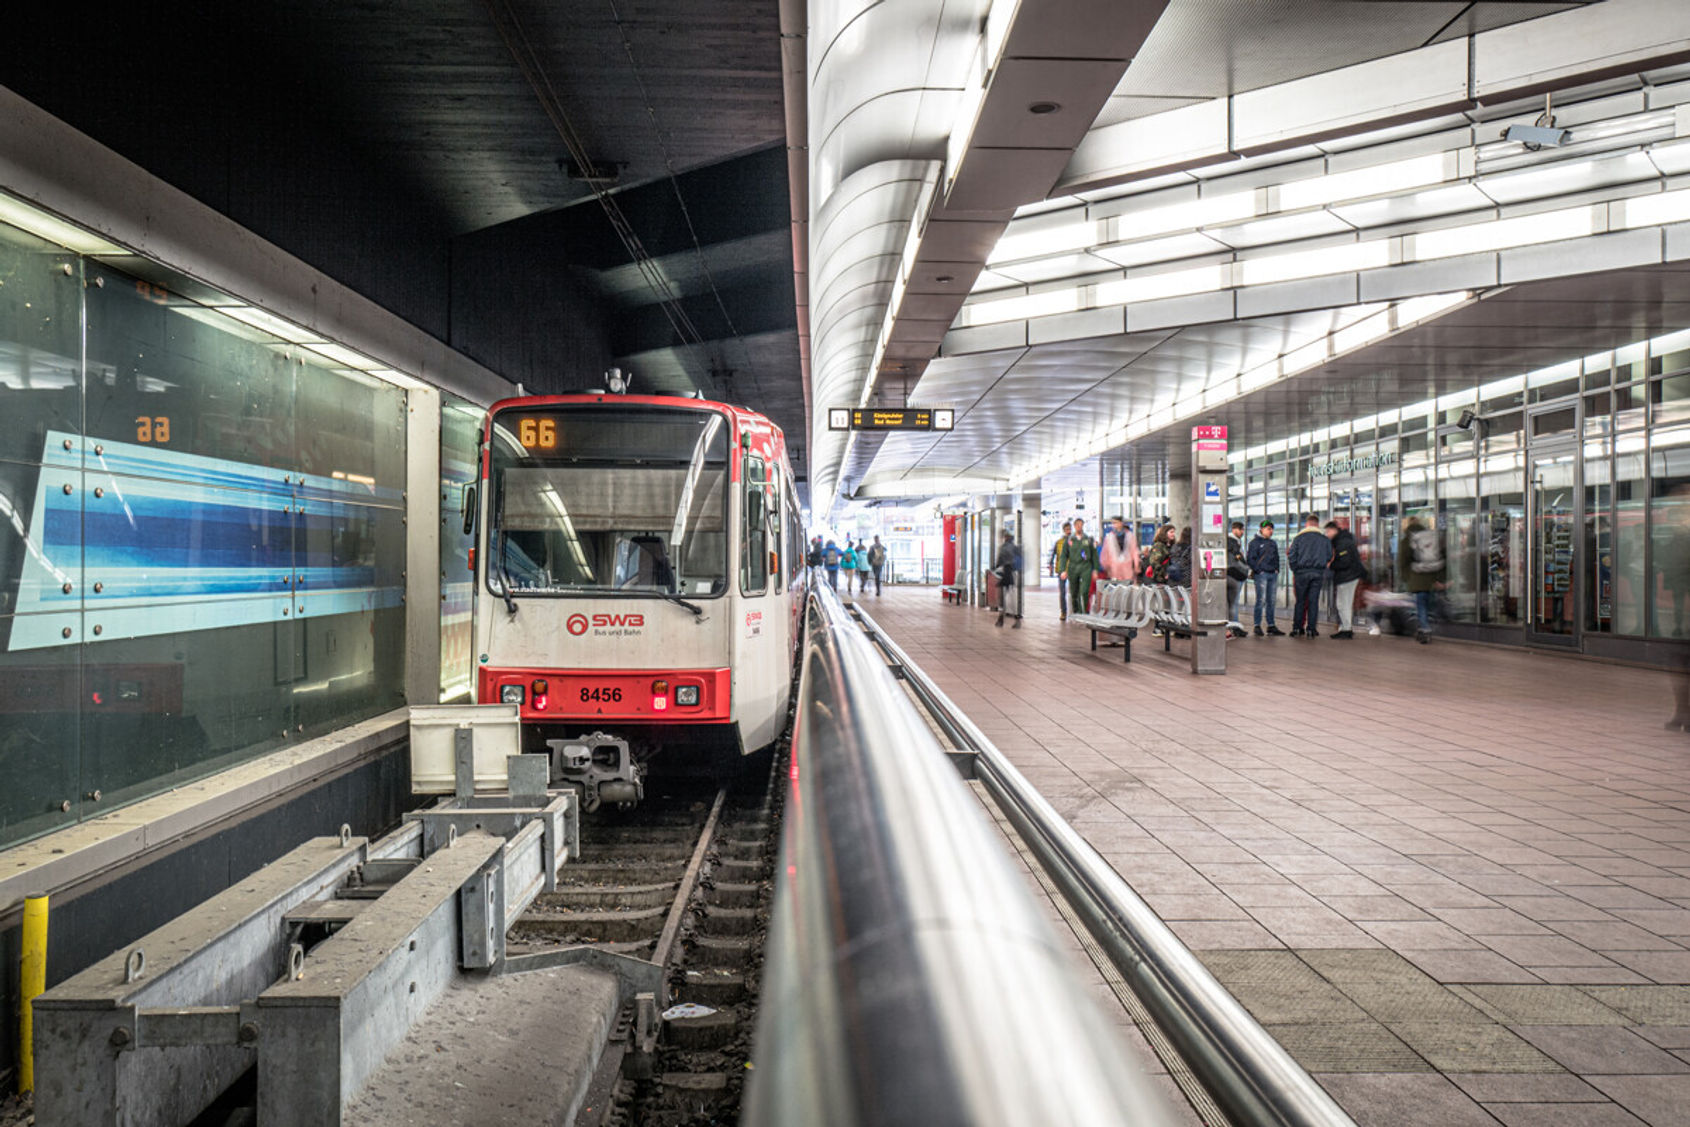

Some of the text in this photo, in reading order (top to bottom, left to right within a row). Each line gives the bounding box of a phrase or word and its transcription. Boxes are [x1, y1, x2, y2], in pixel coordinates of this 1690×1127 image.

[520, 418, 556, 447] 66
[592, 613, 645, 627] SWB
[580, 687, 622, 703] 8456
